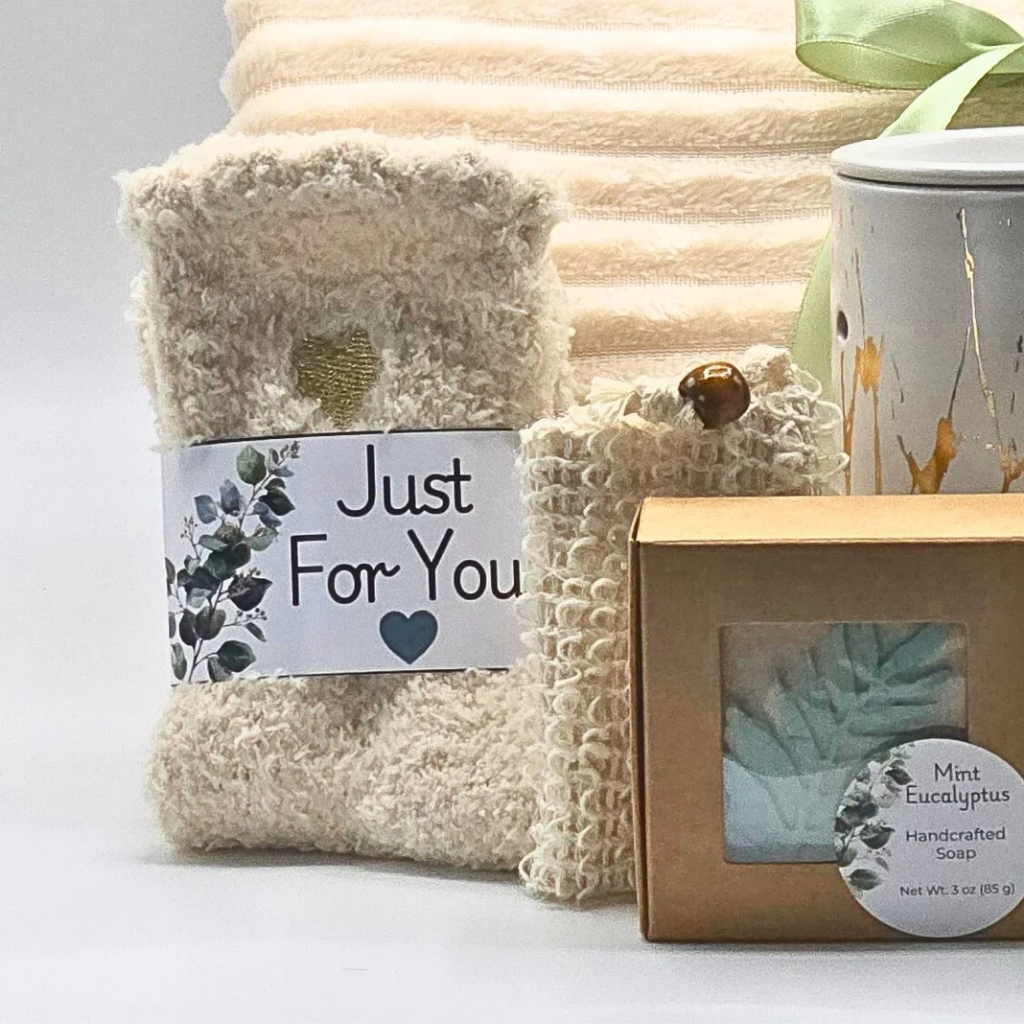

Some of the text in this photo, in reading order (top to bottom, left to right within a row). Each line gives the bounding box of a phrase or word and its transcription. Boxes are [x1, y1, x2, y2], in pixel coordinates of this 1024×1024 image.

[336, 444, 474, 517] Just
[290, 528, 523, 606] For You
[934, 762, 981, 782] Mint
[905, 785, 1010, 811] Eucalyptus
[905, 826, 1006, 843] Handcrafted
[936, 847, 977, 862] Soap
[900, 885, 922, 896] Net
[950, 884, 959, 896] 3
[962, 886, 977, 895] oz
[980, 883, 999, 896] (85
[1002, 882, 1016, 896] g)
